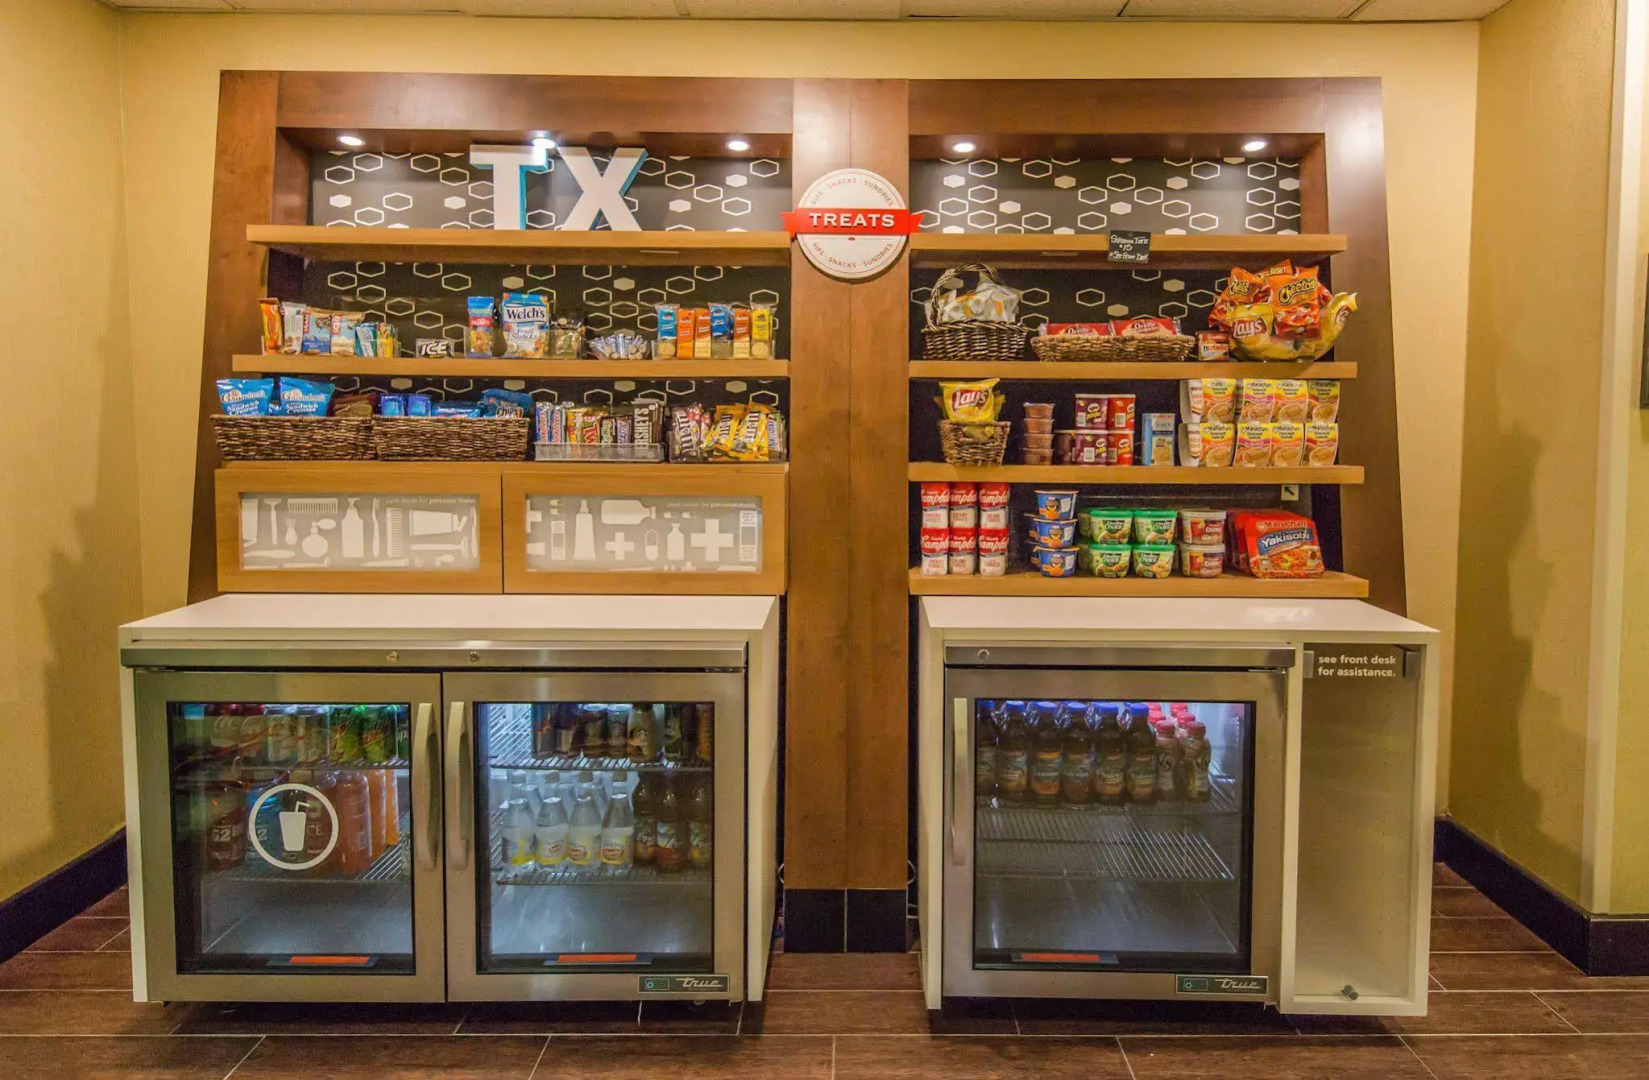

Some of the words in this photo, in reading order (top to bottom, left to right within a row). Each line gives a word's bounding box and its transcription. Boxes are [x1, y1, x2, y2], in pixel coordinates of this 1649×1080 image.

[470, 144, 648, 231] TX
[864, 180, 894, 207] SUNDRIES
[809, 213, 895, 228] TREATS
[812, 242, 825, 256] SIPS
[828, 257, 857, 269] SNACKS
[863, 243, 893, 267] SUNDRIES
[1278, 278, 1317, 305] Cheetos
[506, 307, 546, 319] Welch's
[420, 340, 449, 356] ICE
[1261, 532, 1310, 547] Yakisoba
[1318, 656, 1337, 664] see
[1340, 655, 1369, 664] front
[1371, 655, 1396, 664] desk
[1318, 667, 1335, 676] for
[1337, 666, 1396, 677] assistance.
